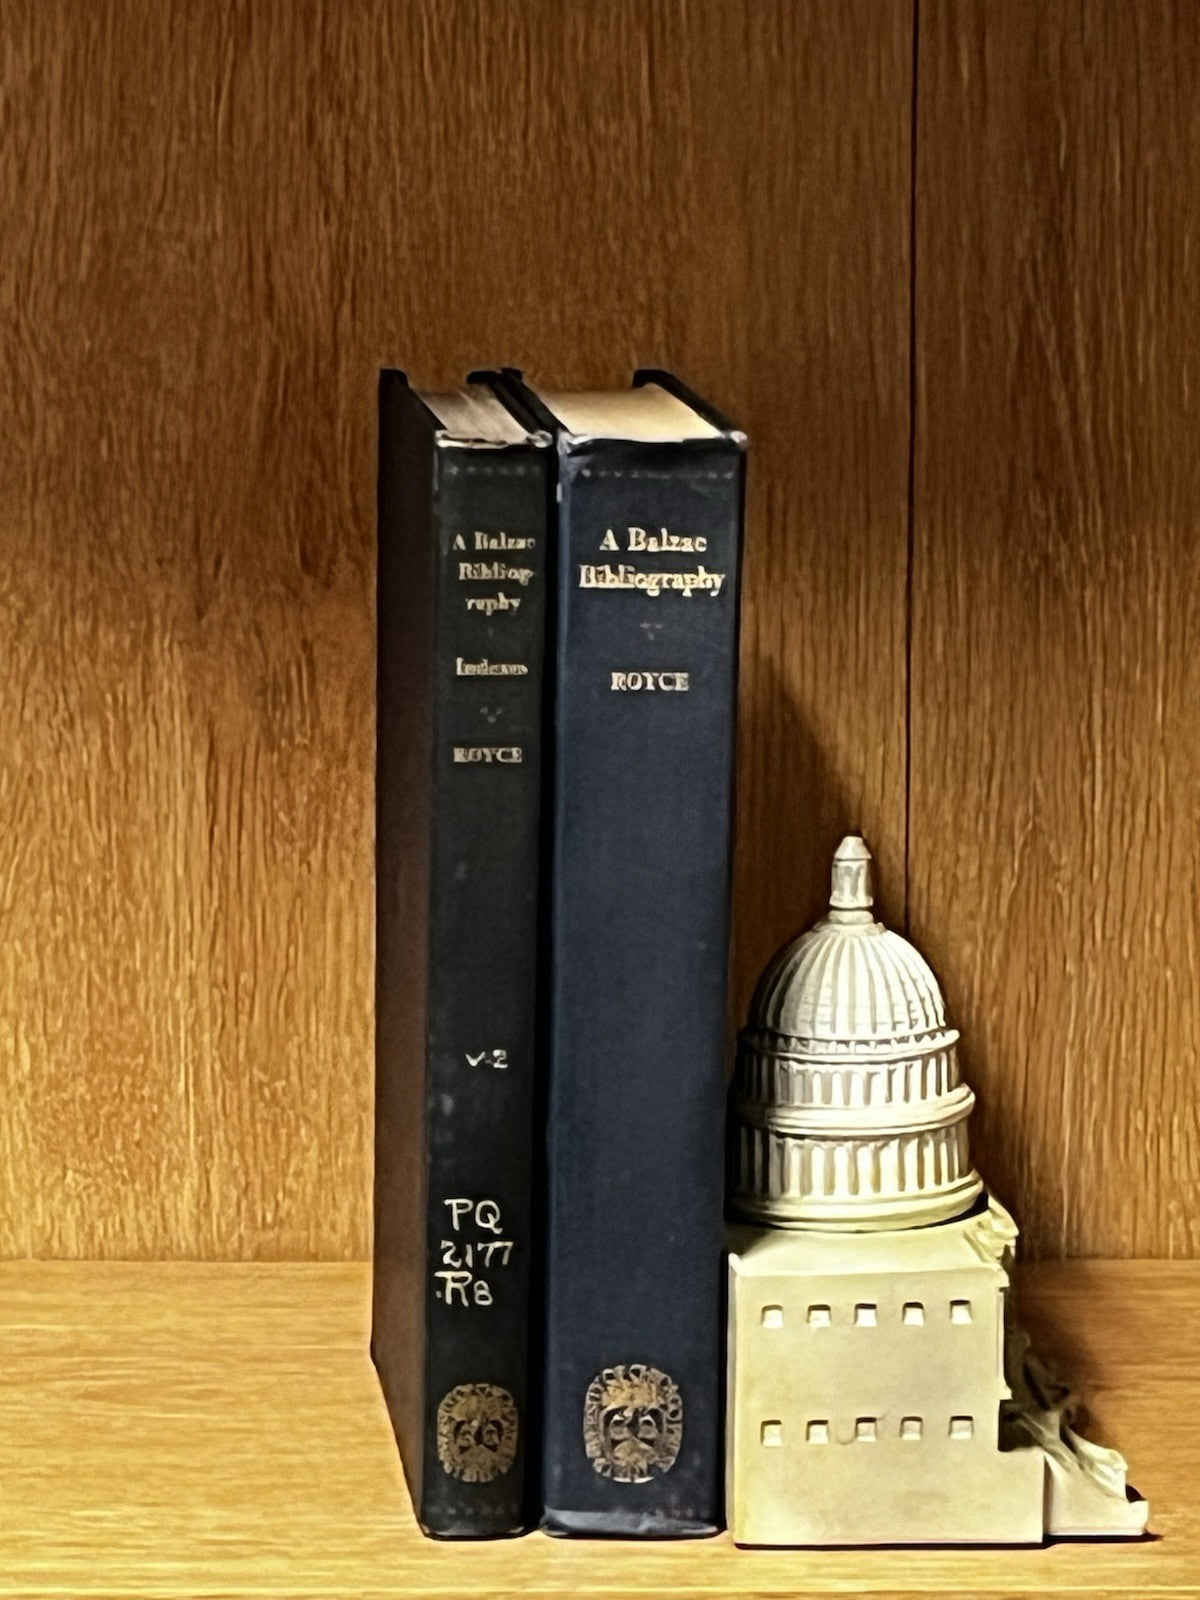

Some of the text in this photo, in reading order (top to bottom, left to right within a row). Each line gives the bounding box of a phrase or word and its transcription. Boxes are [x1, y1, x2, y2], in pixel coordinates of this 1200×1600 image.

[452, 531, 536, 550] A Balzac
[599, 527, 707, 552] A Balzac
[578, 564, 726, 597] Bibliography
[610, 671, 689, 691] ROYCE
[453, 747, 523, 763] ROYCE
[444, 1198, 503, 1234] PQ
[440, 1239, 514, 1268] 2177
